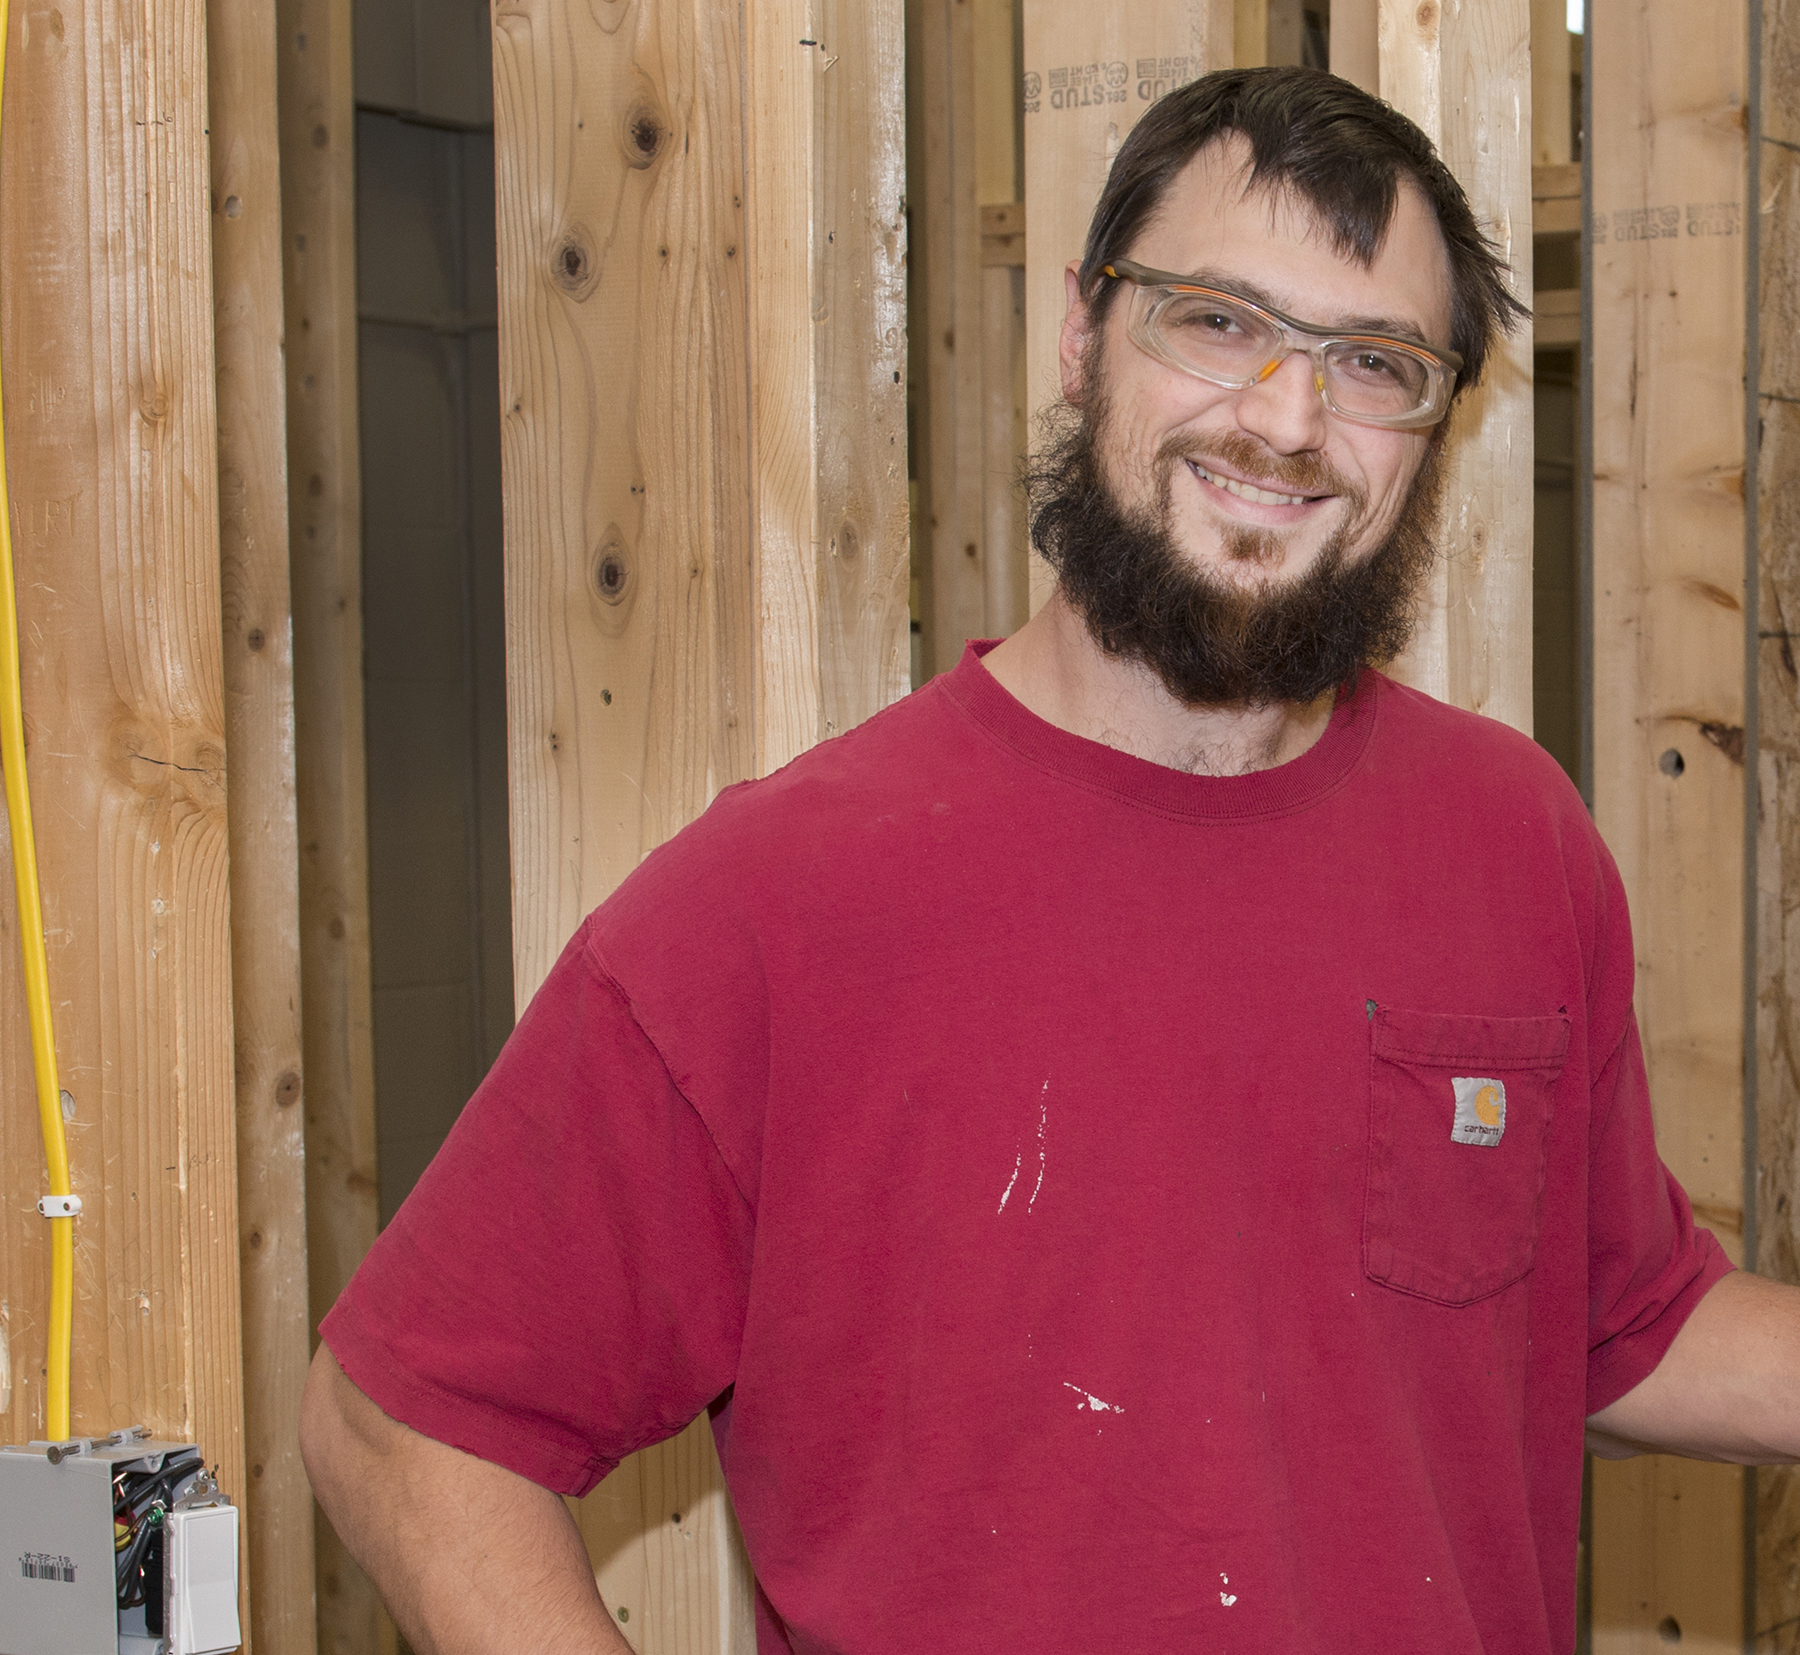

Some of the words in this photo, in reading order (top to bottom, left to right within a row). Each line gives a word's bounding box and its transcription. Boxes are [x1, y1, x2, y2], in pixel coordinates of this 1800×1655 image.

[1070, 66, 1083, 76] HT
[1085, 63, 1098, 74] KD
[1050, 84, 1105, 109] STUD
[1464, 1125, 1499, 1135] carhartt
